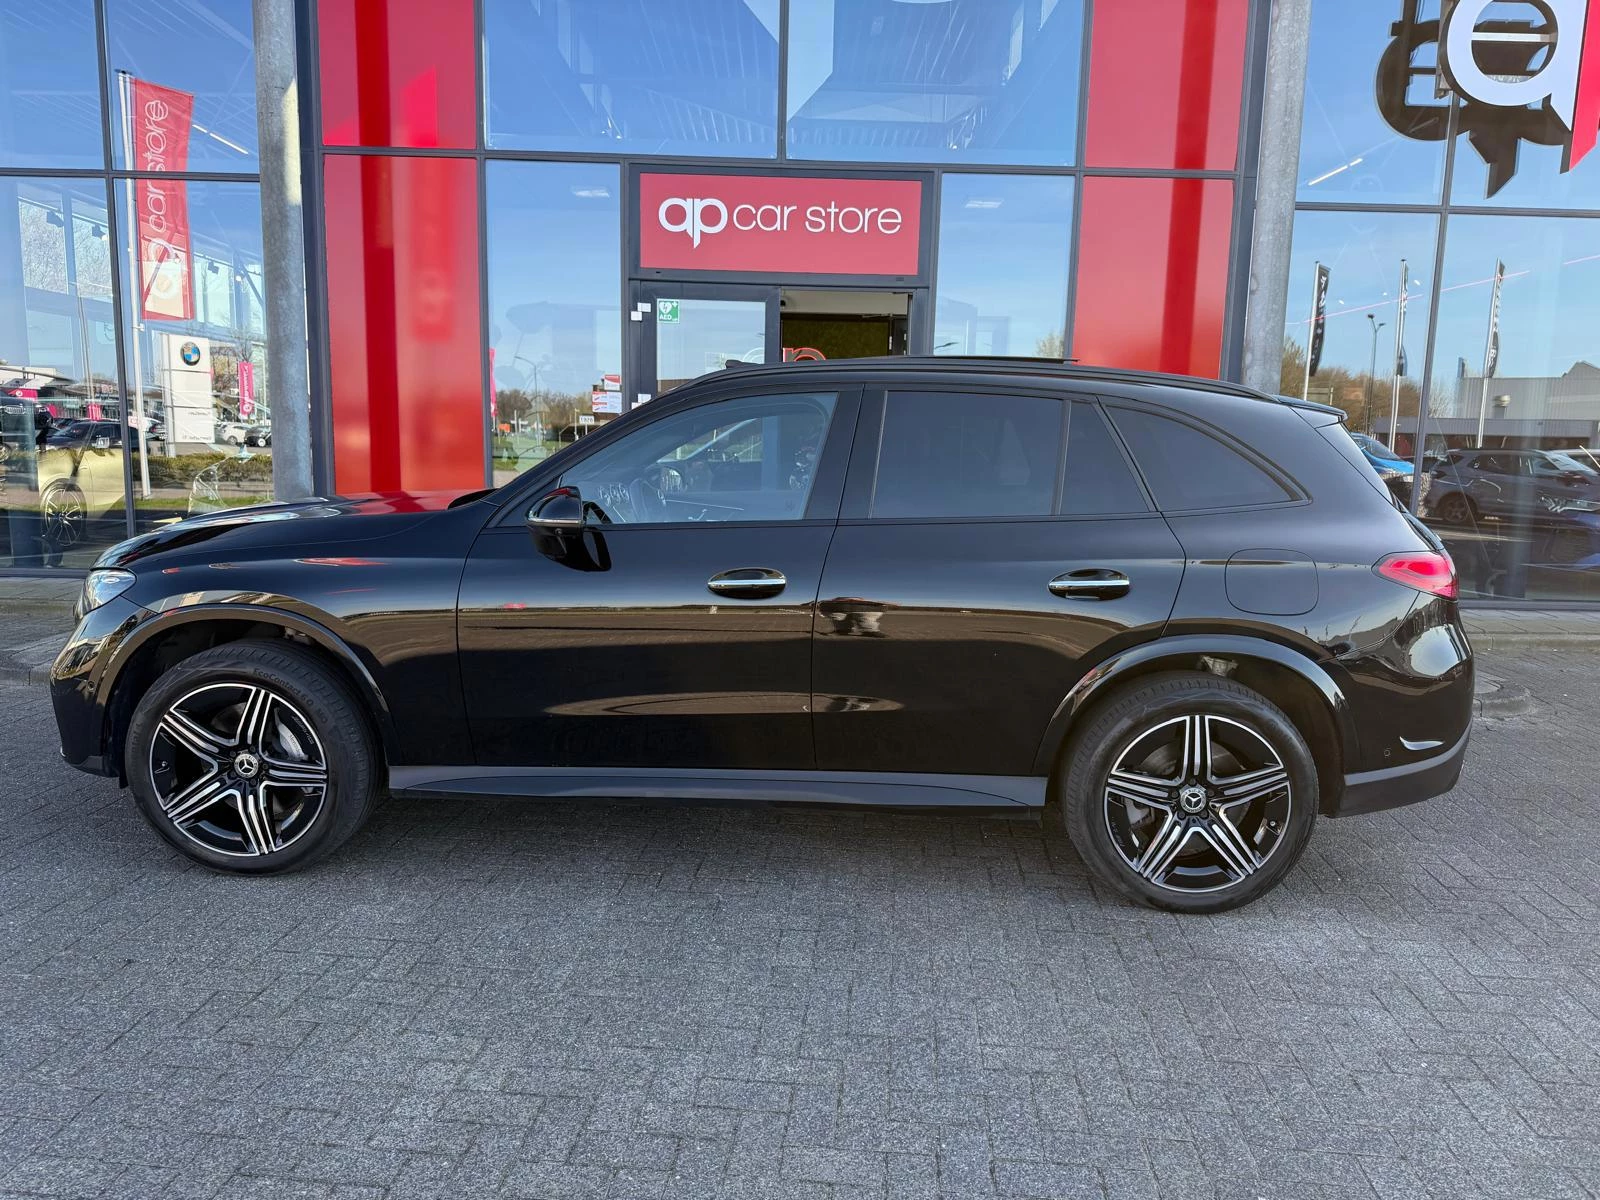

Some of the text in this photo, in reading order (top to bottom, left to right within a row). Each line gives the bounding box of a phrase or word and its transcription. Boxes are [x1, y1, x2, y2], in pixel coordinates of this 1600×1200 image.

[146, 179, 166, 233] car
[658, 198, 902, 248] ap car store
[254, 668, 301, 695] EcoContact
